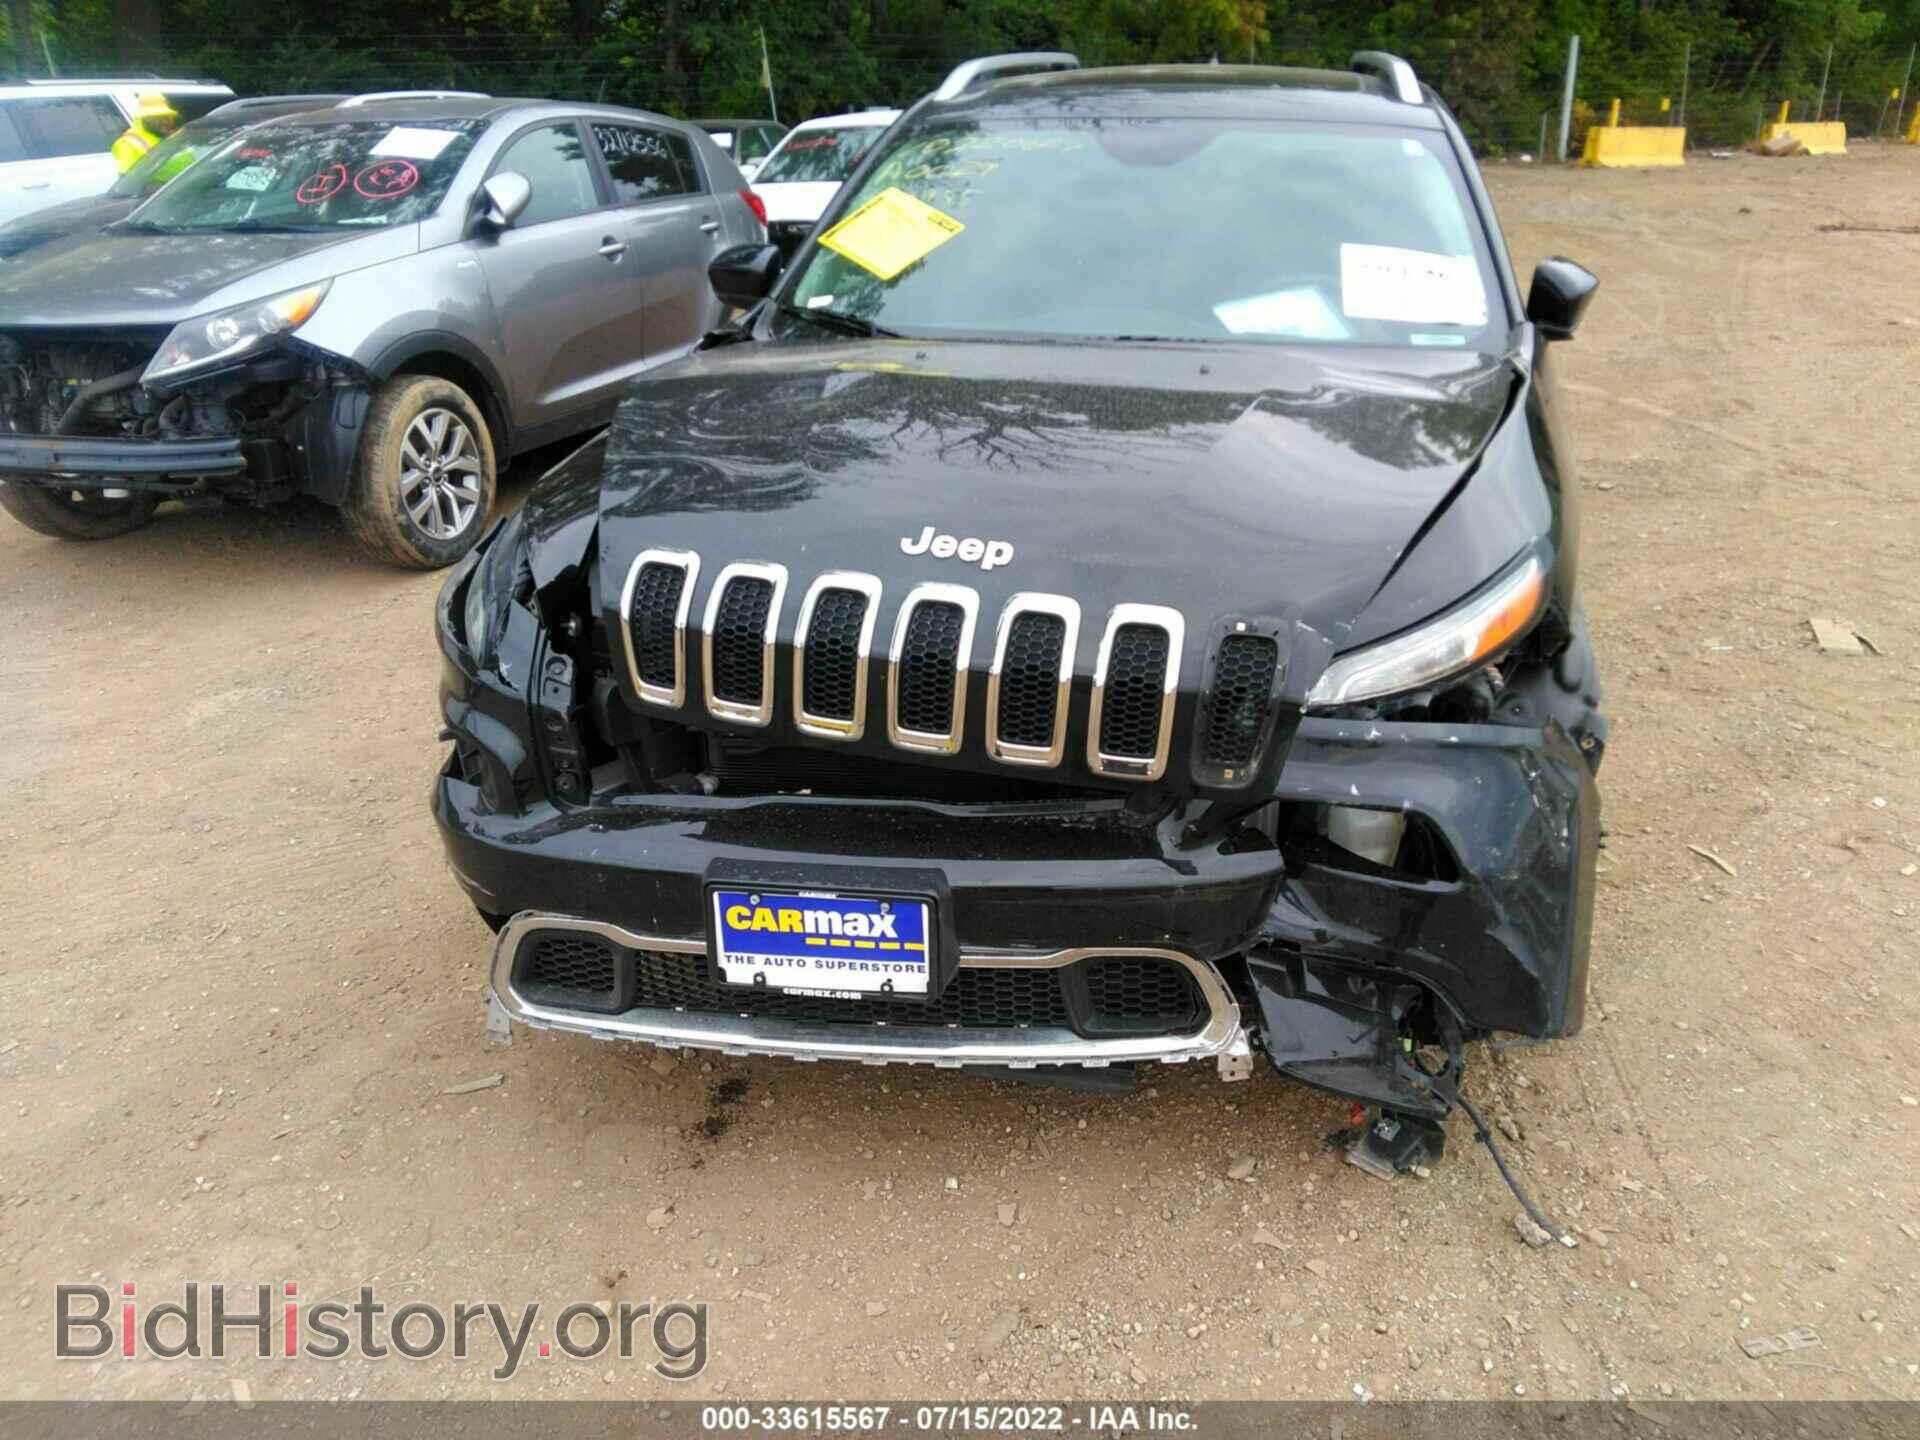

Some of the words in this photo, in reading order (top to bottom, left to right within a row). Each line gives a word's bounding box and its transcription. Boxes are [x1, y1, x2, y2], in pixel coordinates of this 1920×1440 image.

[900, 525, 1015, 571] Jeep
[725, 904, 898, 938] CARmax
[724, 955, 756, 966] THE
[763, 957, 807, 969] AUTO
[815, 959, 927, 974] SUPERSTORE
[783, 986, 862, 1000] carmax.com
